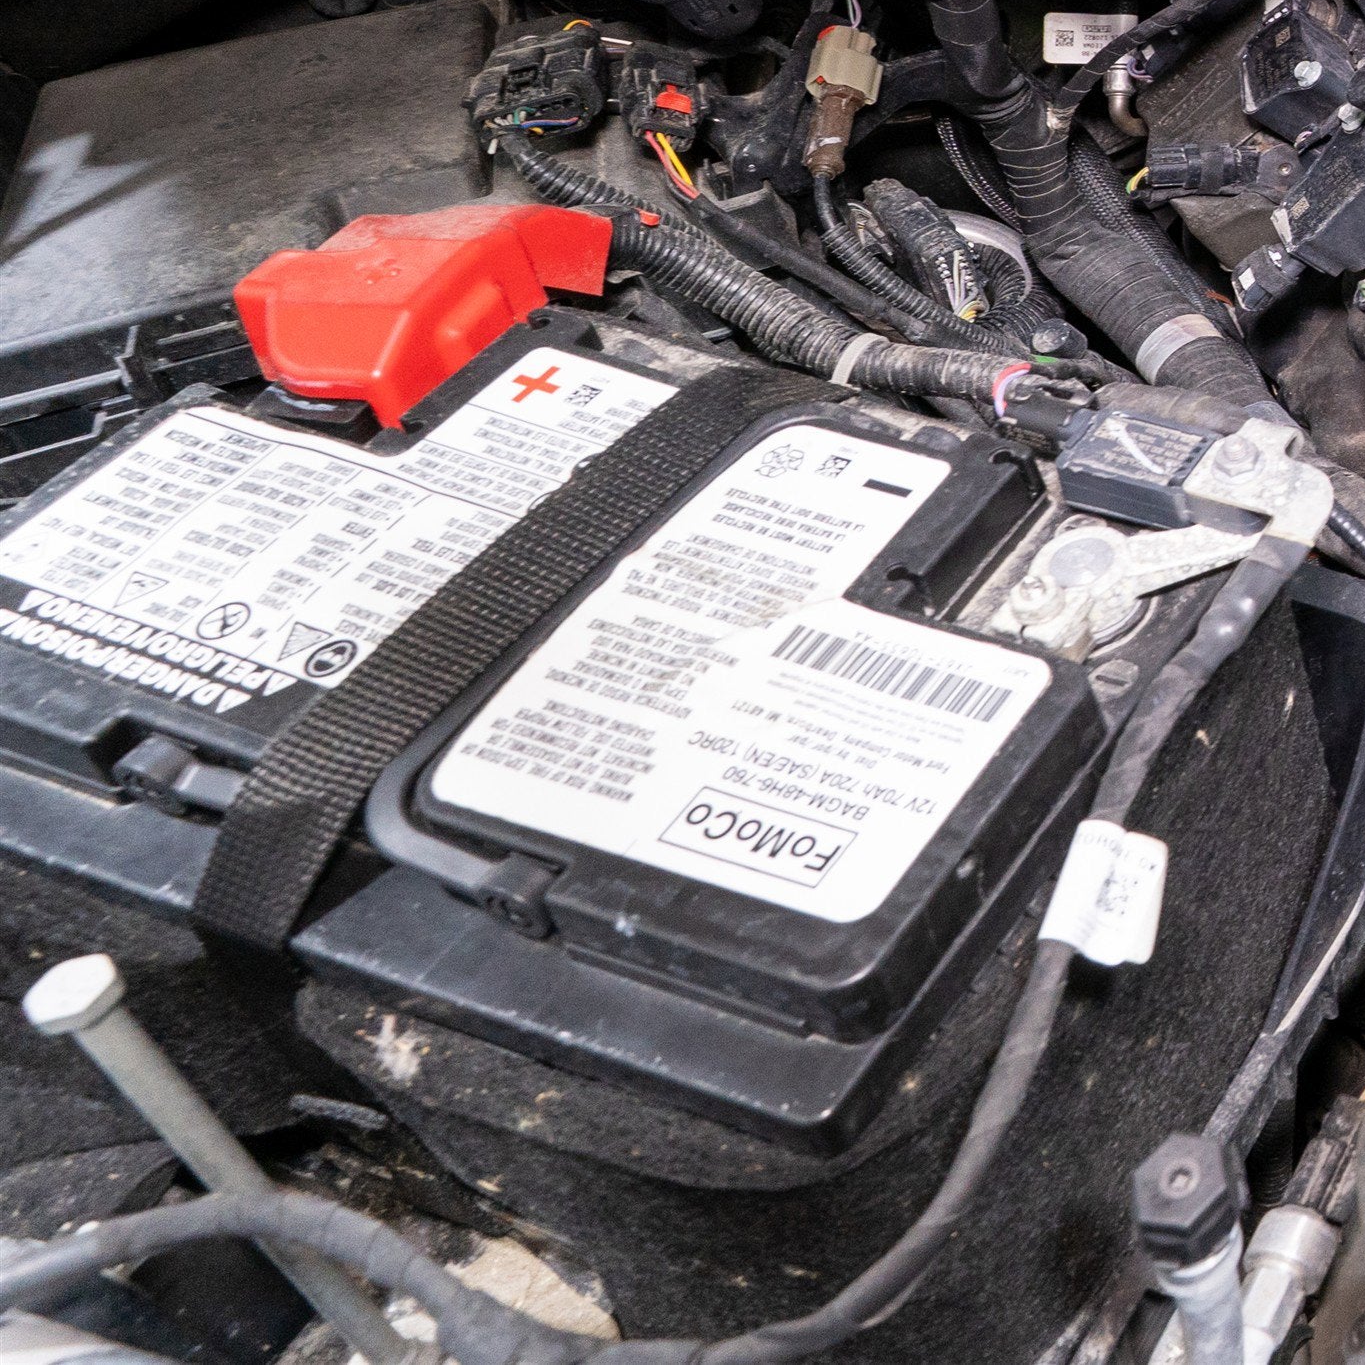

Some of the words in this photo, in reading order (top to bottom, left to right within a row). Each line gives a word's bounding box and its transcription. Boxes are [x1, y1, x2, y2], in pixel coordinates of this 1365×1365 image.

[722, 501, 774, 522] RECICLARSE
[790, 507, 813, 518] DOIT
[712, 513, 756, 532] RECYCLED
[773, 516, 798, 529] DEBE
[812, 512, 853, 529] BATTERIE
[852, 523, 865, 531] LA
[756, 526, 770, 536] BE
[768, 531, 795, 543] MUST
[833, 533, 846, 541] LA
[794, 539, 834, 554] BATTERY
[39, 596, 270, 688] PELIGRO/VENENO
[4, 615, 223, 703] DANGER/POISON
[731, 701, 765, 717] 48121
[766, 711, 782, 722] MI
[687, 730, 739, 756] 120RC
[743, 745, 819, 779] (SAE/EN)
[893, 752, 924, 767] Motor
[924, 760, 951, 775] Ford
[819, 770, 859, 793] 720A
[722, 766, 869, 820] BAGM-48H6-760
[863, 784, 904, 806] 70Ah
[903, 797, 937, 815] 12V
[686, 804, 840, 871] FoMoCo
